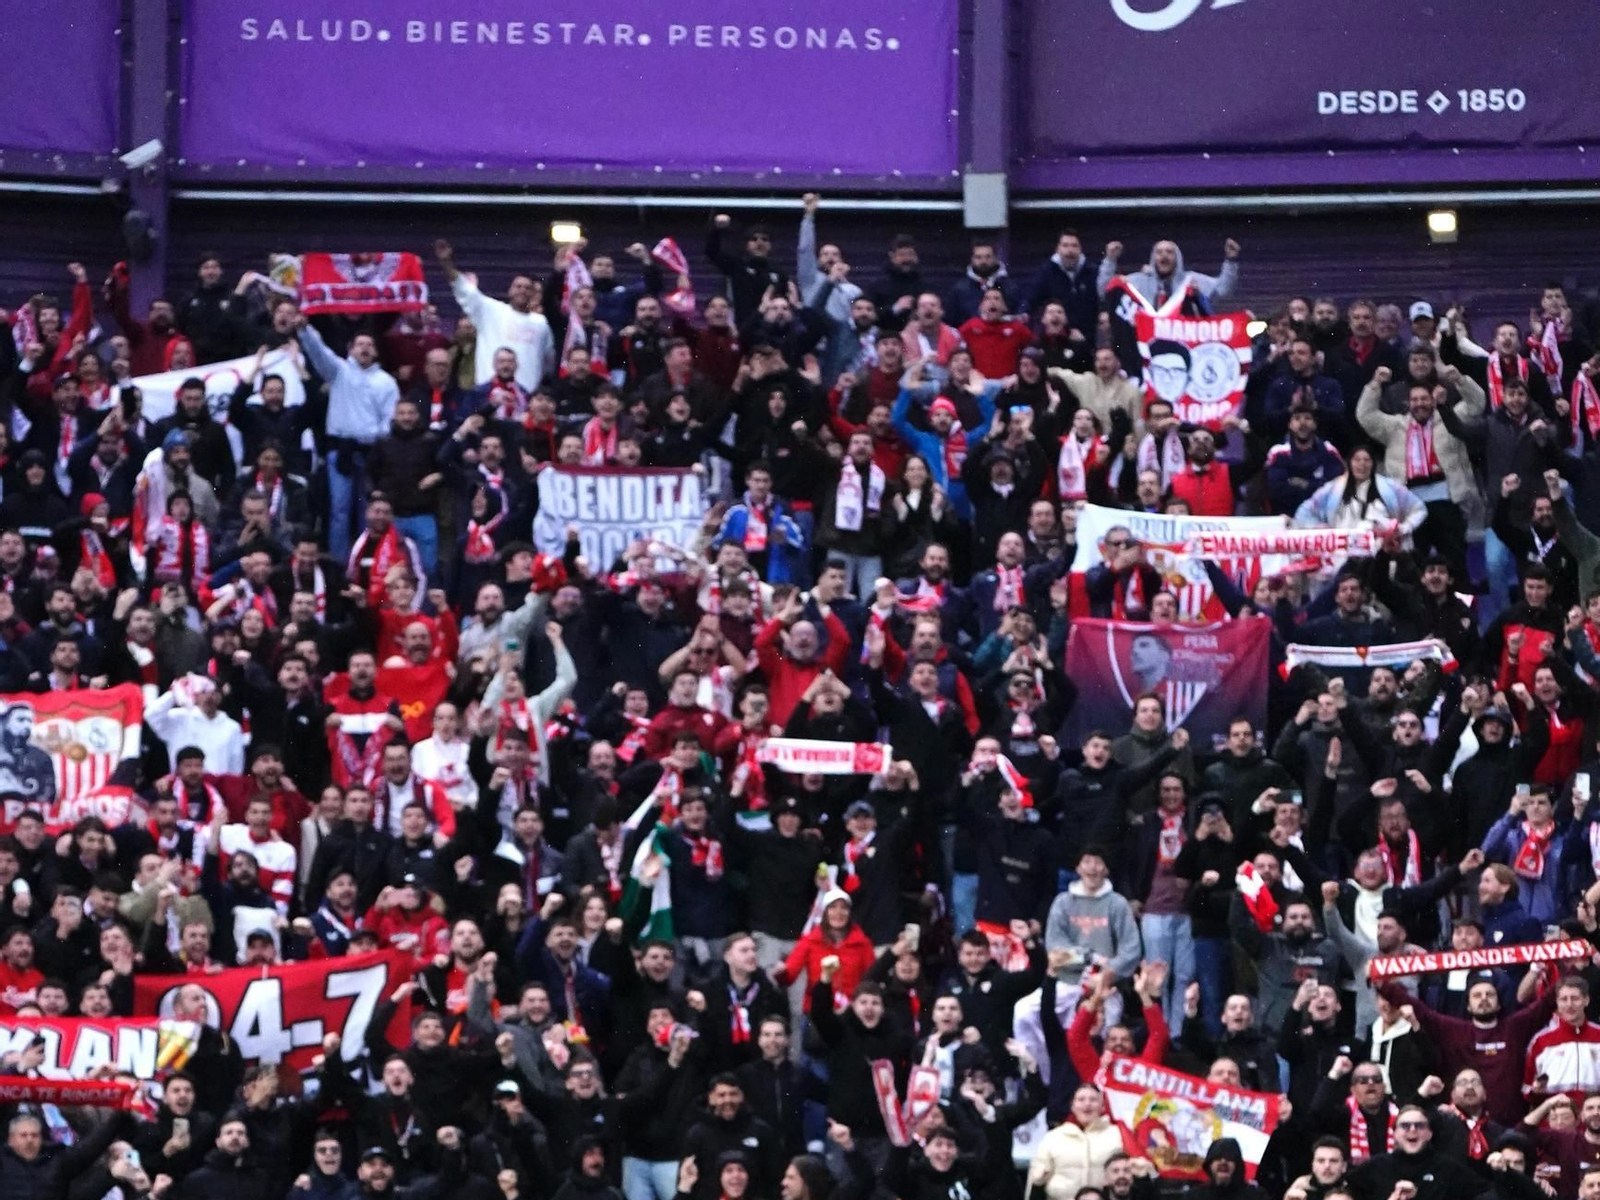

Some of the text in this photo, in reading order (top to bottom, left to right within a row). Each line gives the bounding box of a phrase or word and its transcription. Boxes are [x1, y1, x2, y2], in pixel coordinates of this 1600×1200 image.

[240, 18, 900, 51] SALUD. BIENESTAR. PERSONAS.
[1317, 88, 1526, 115] DESDE 1850
[1153, 318, 1234, 343] MANOLO
[555, 473, 702, 521] BENDITA
[4, 794, 131, 829] PLACIOS
[1374, 939, 1586, 976] VAYAS DONDE VAYAS
[1113, 1057, 1268, 1113] CANTILLANA
